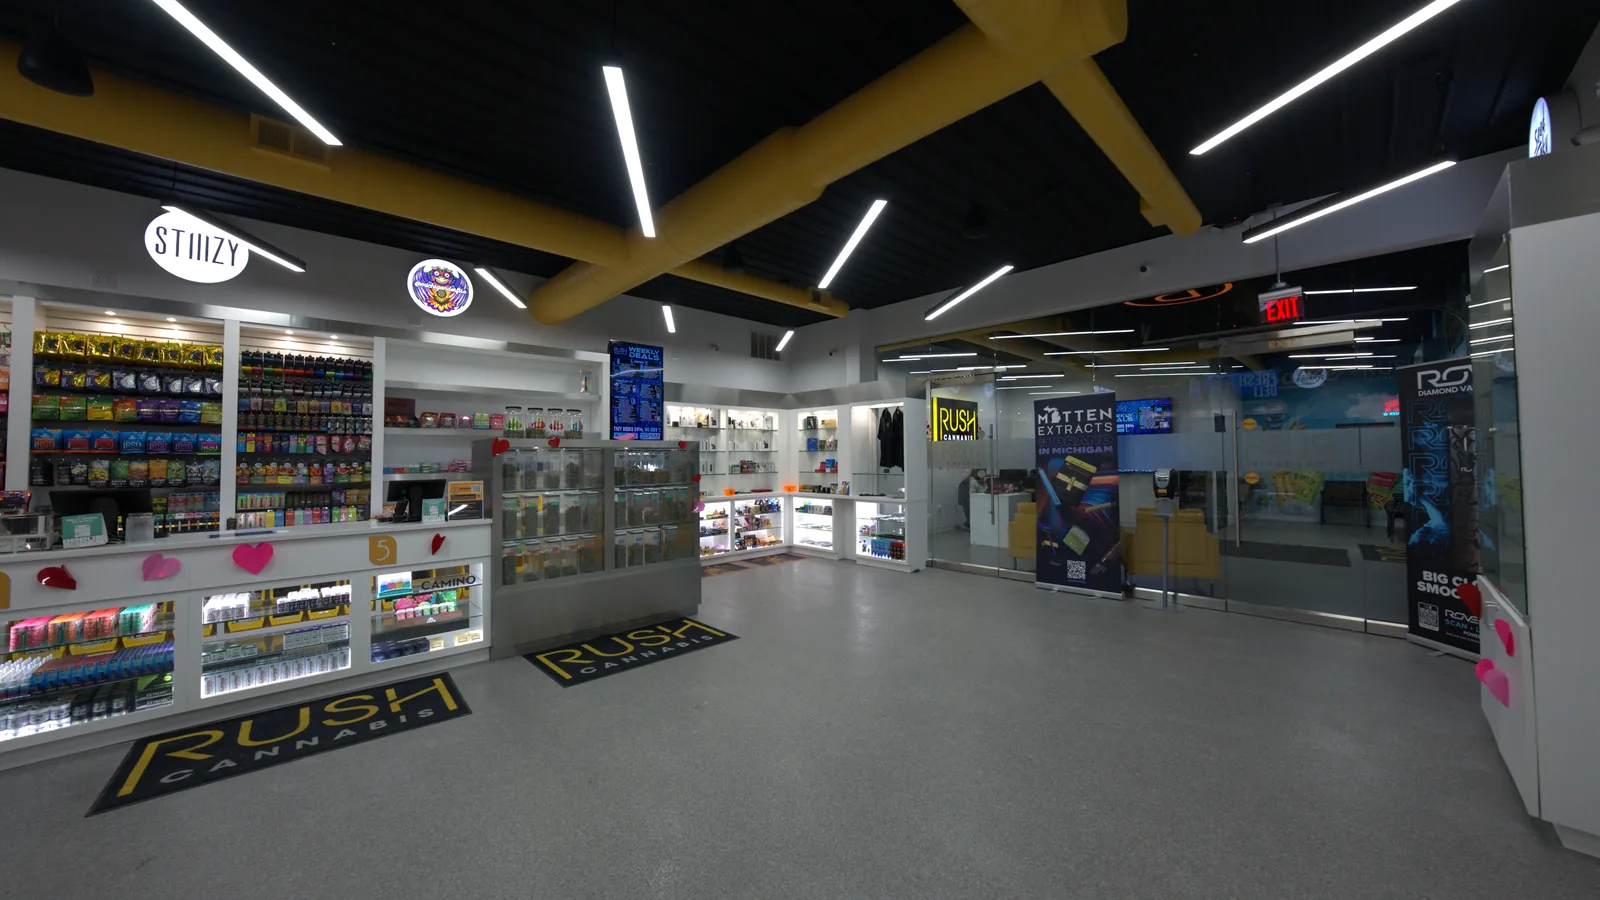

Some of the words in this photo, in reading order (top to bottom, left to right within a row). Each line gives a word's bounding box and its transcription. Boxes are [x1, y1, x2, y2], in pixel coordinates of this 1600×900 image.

[155, 226, 239, 266] STIIIZY
[1266, 297, 1299, 321] EXIT
[628, 346, 660, 356] WEEKLY
[628, 352, 660, 361] DEALS
[1418, 386, 1459, 397] DIAMOND
[940, 407, 977, 440] RUSH
[1037, 422, 1113, 436] EXTRACTS
[1039, 447, 1050, 455] IN
[1051, 445, 1113, 455] MICHIGAN
[376, 540, 390, 561] 5
[421, 575, 476, 591] CAMINO
[1422, 570, 1449, 585] BIG
[535, 619, 726, 680] RUSH
[580, 635, 713, 675] CANNABIS
[116, 677, 457, 798] RUSH
[159, 708, 435, 785] CANNABIS
